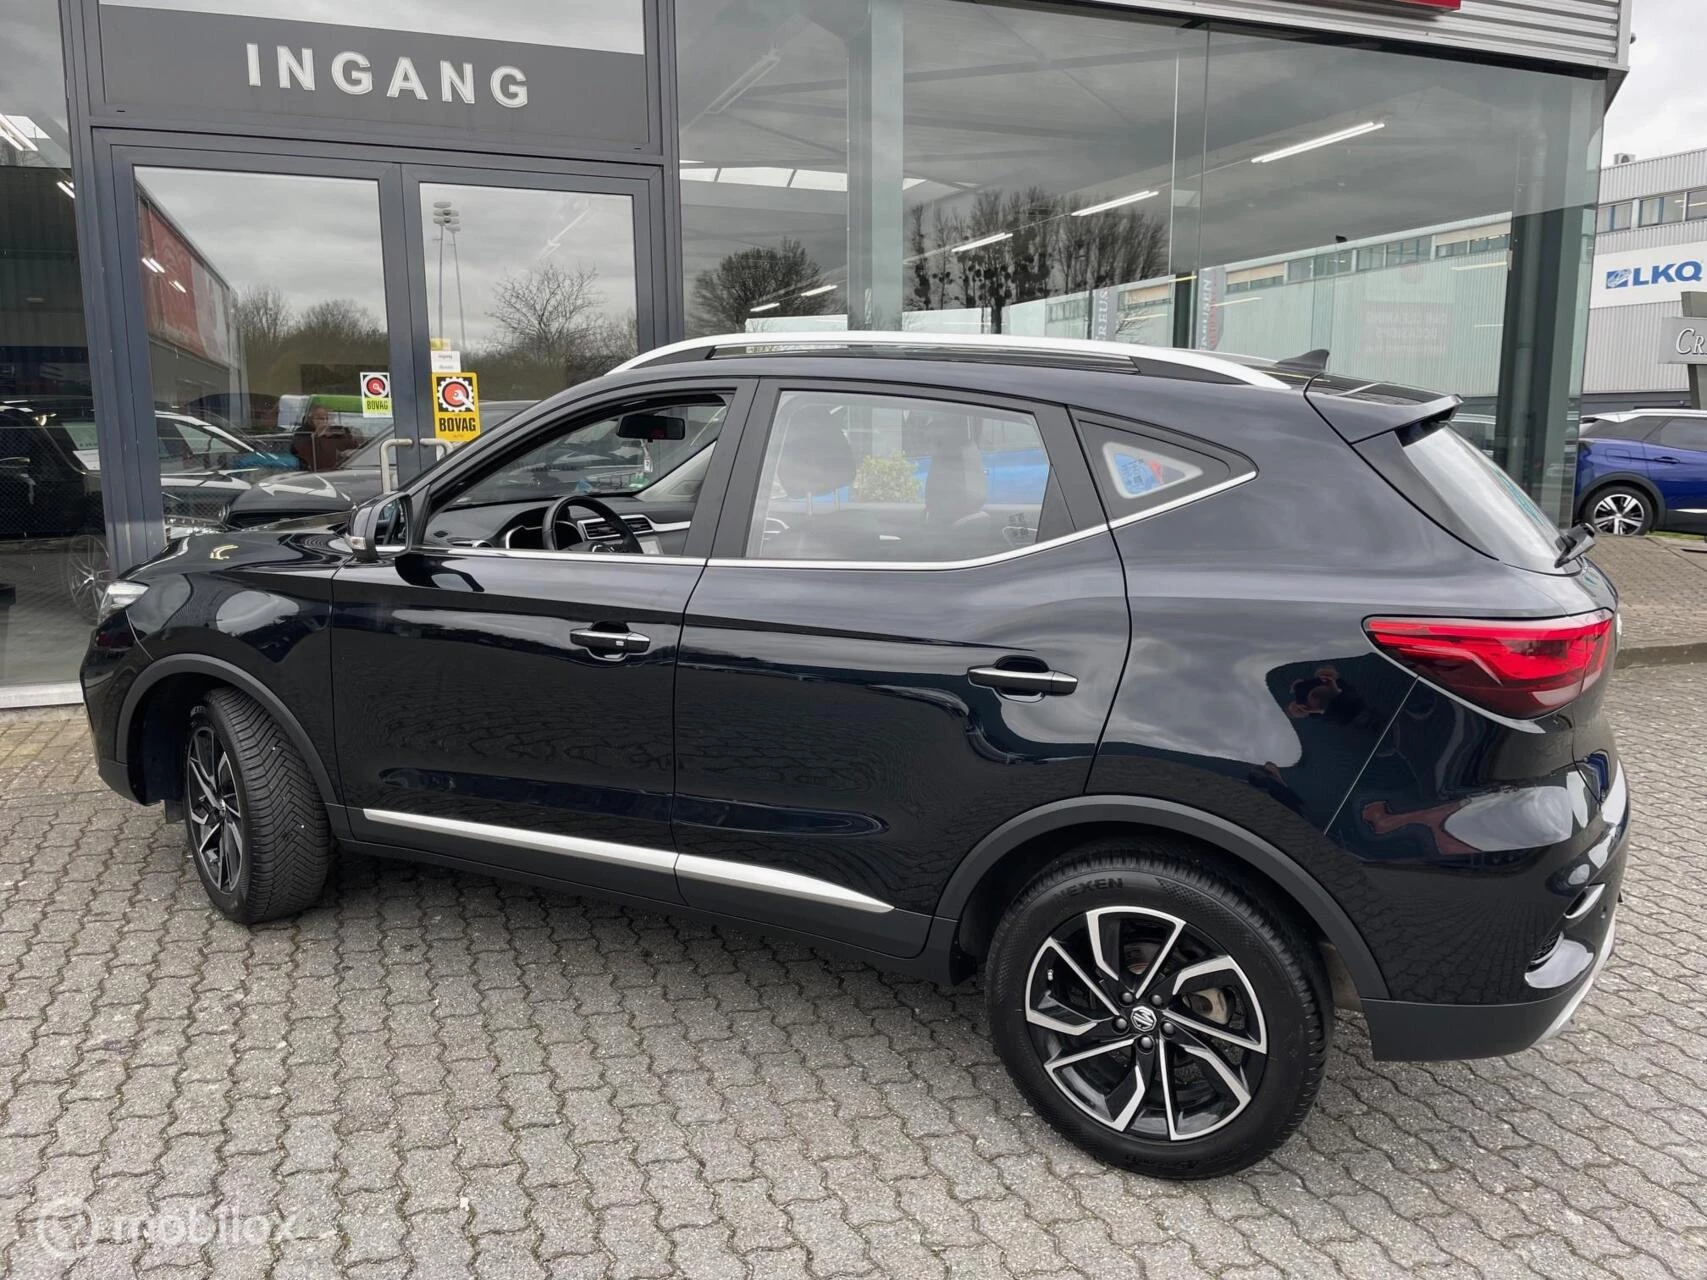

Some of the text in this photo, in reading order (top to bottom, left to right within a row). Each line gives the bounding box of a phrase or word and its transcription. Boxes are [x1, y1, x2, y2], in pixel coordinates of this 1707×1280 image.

[245, 42, 530, 109] INGANG
[1632, 260, 1703, 286] LKQ
[1675, 327, 1707, 355] CR
[366, 400, 389, 410] BOVAG
[439, 417, 476, 432] BOVAG
